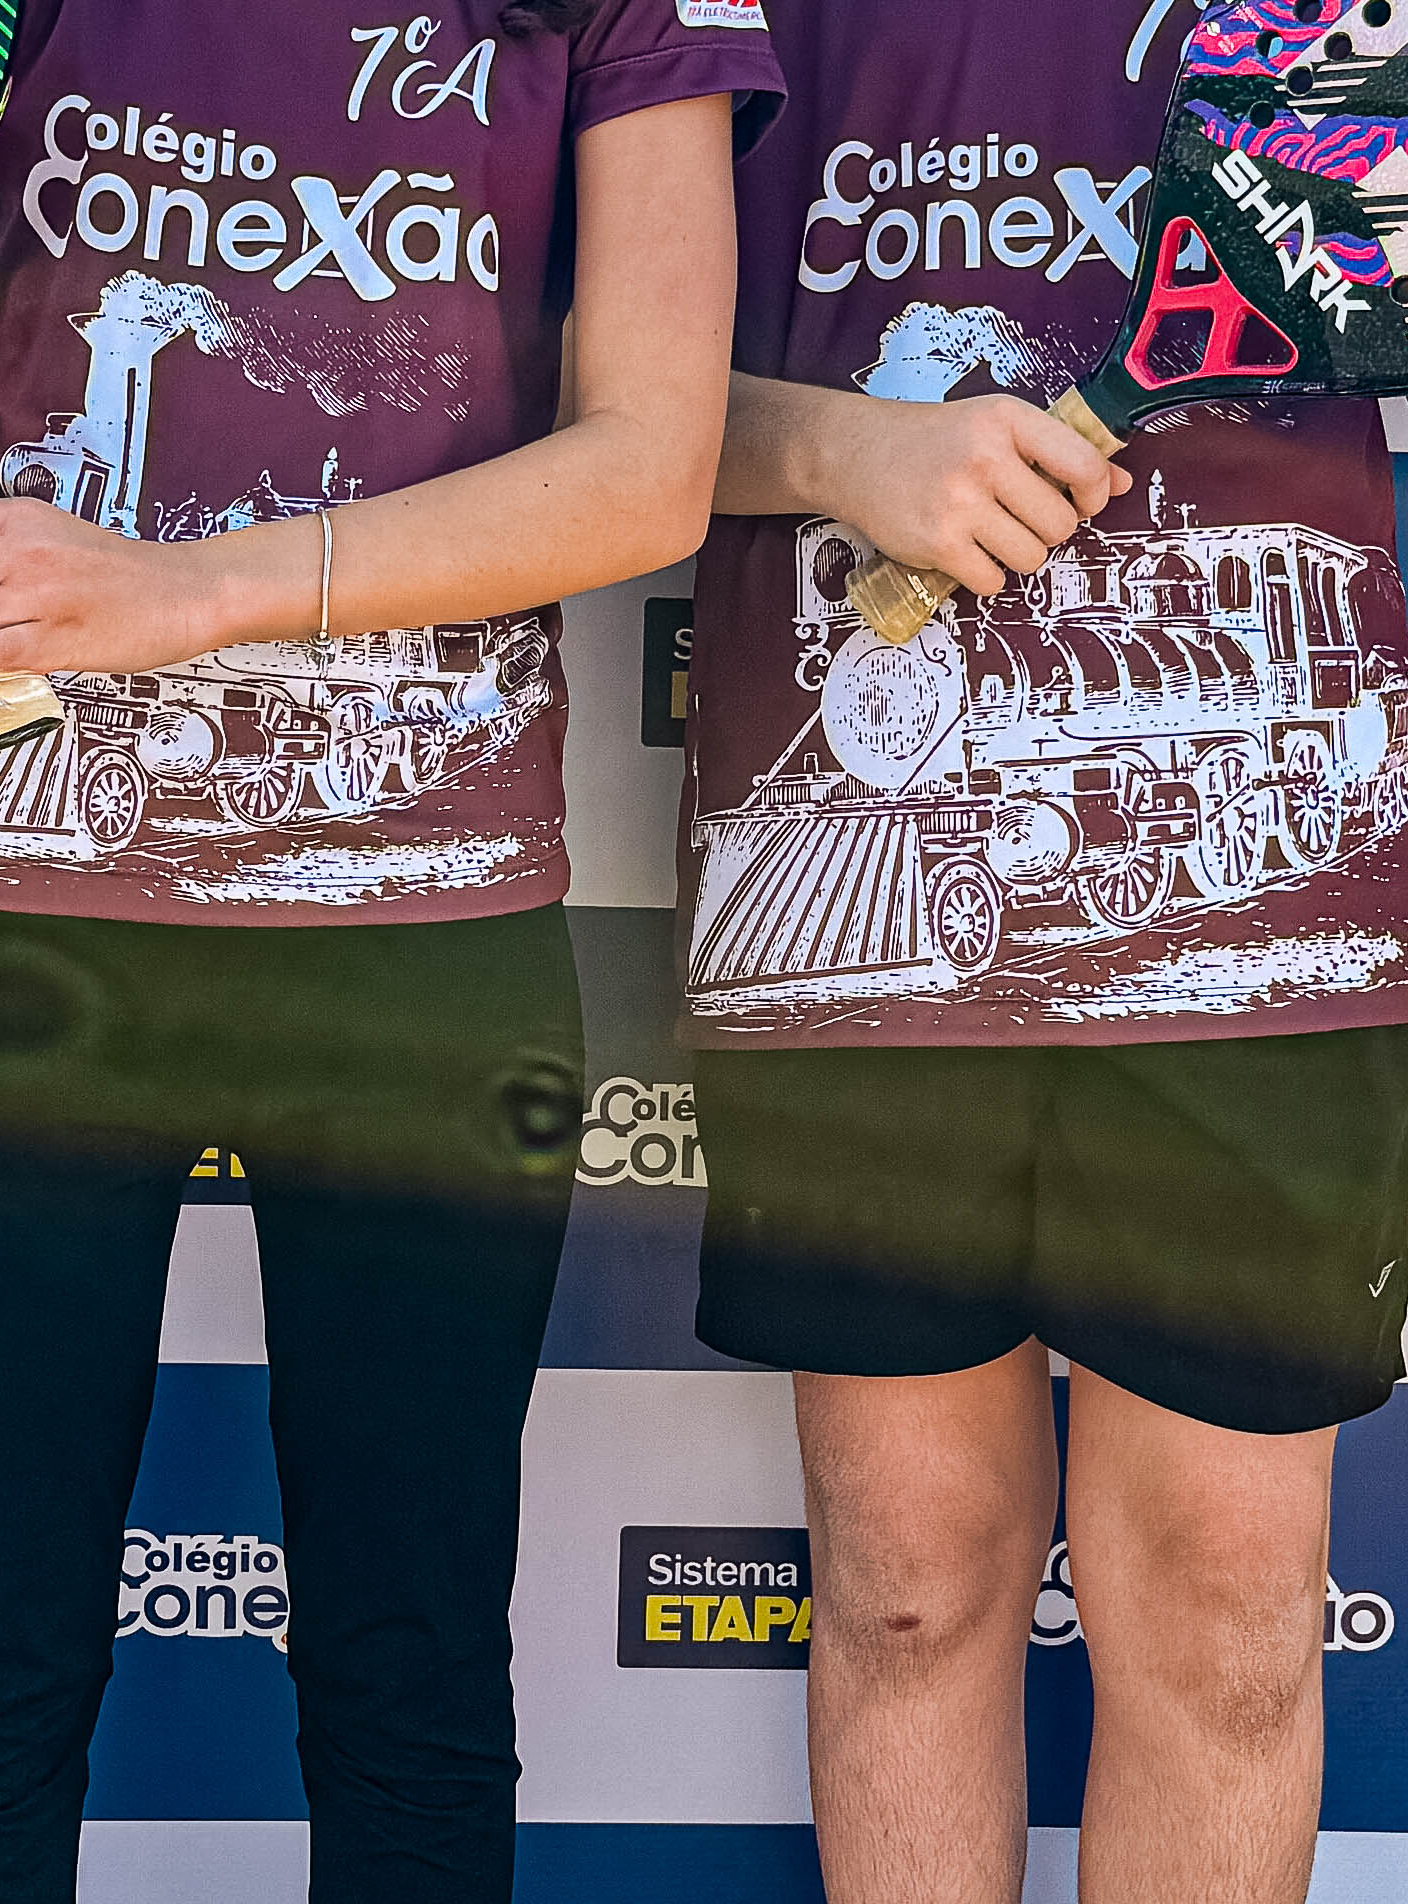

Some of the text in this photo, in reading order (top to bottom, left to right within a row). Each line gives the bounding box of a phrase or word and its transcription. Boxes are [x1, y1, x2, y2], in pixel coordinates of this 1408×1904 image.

[42, 93, 278, 184] Colégio
[823, 133, 1040, 209] Colégio
[1211, 149, 1372, 335] SHARK
[647, 1553, 797, 1585] Sistema
